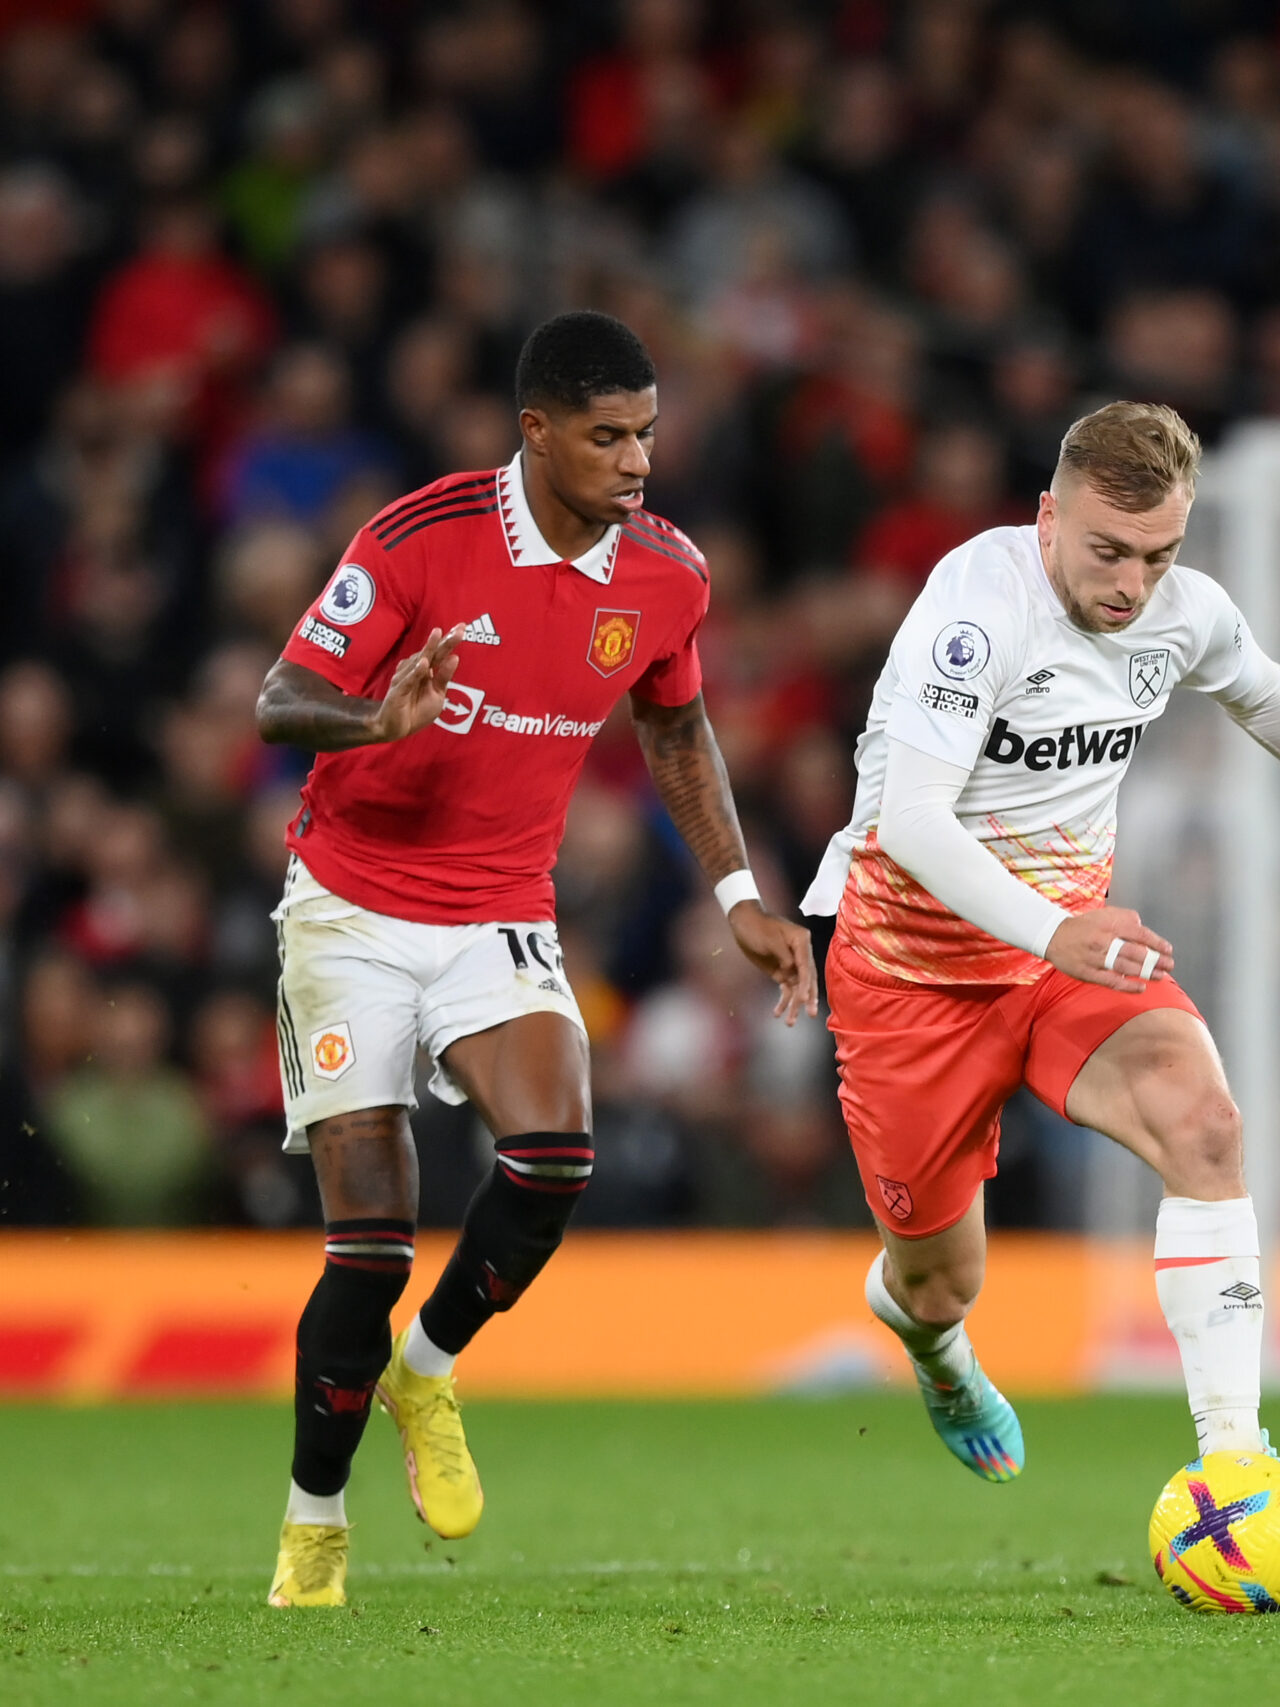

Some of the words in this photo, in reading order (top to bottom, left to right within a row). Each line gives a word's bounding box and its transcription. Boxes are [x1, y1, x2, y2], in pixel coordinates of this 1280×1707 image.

[314, 622, 346, 647] room
[922, 683, 938, 698] No
[940, 690, 974, 708] room
[1025, 683, 1050, 695] umbro
[482, 704, 607, 737] TeamViewe
[937, 699, 976, 719] racism
